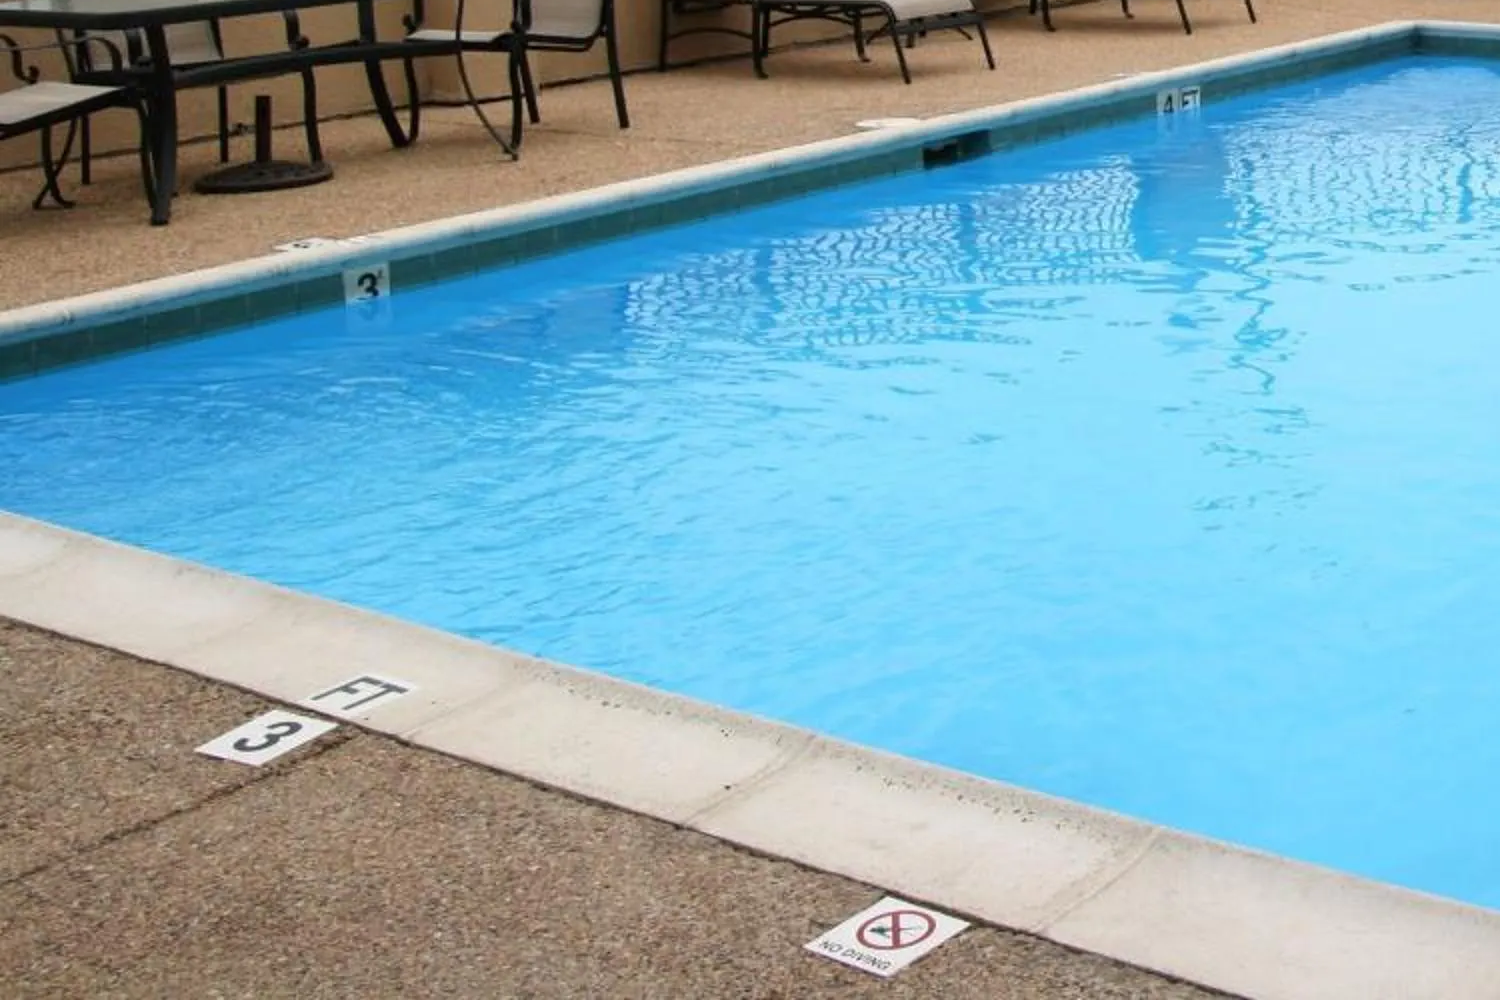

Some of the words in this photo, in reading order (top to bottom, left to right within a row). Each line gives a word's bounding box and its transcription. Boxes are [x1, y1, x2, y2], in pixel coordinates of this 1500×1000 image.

[312, 676, 408, 711] FT
[233, 721, 303, 752] 3
[820, 940, 839, 953] NO
[840, 947, 892, 971] DIVING
